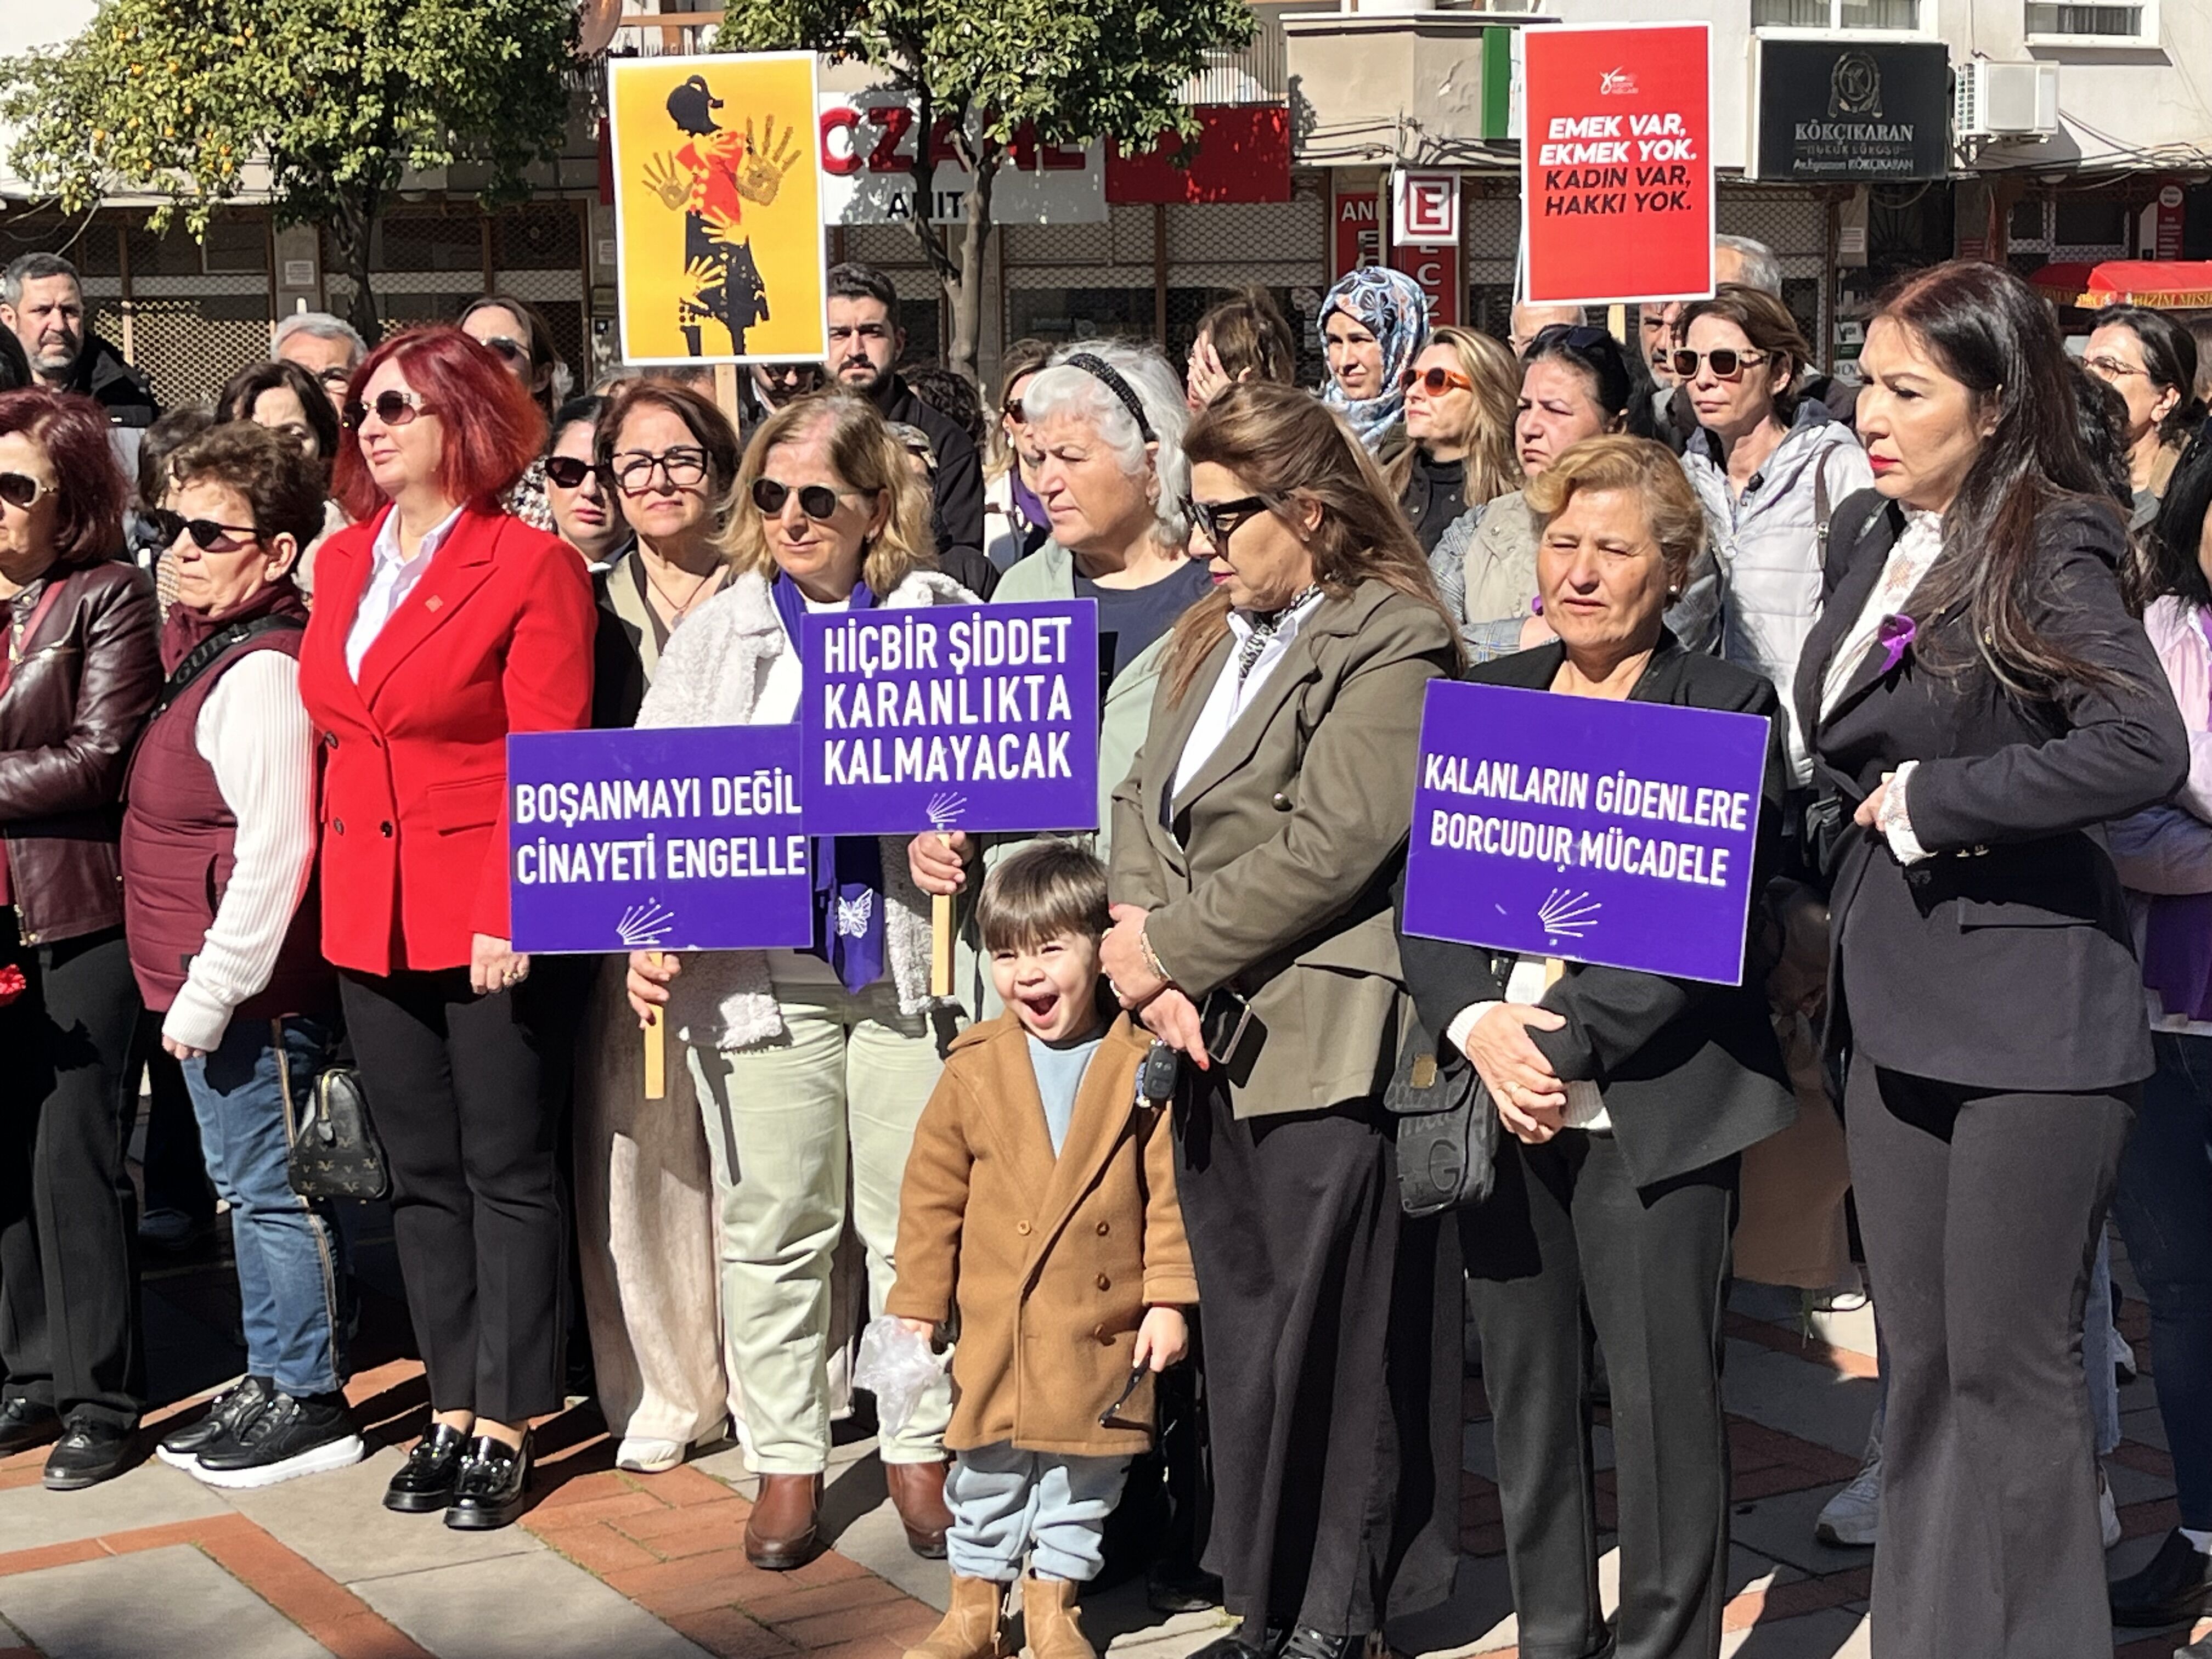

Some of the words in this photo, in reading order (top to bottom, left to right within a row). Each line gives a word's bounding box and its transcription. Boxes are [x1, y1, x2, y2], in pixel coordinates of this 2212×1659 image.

[1539, 140, 1631, 166] EKMEK
[1638, 138, 1697, 162] YOK.
[1549, 115, 1622, 139] EMEK
[1629, 113, 1686, 137] VAR,
[1795, 119, 1914, 145] KÖKÇIKARAN
[1545, 167, 1628, 190] KADIN
[1635, 165, 1691, 188] VAR,
[1545, 193, 1626, 216] HAKKI
[1634, 190, 1691, 212] YOK.
[824, 615, 939, 679] HİÇBİR
[948, 612, 1072, 675] ŞİDDET
[824, 674, 1072, 729] KARANLIKTA
[824, 731, 1072, 786] KALMAYACAK
[516, 777, 701, 827] BOŞANMAYI
[712, 766, 802, 817] DEĞİL
[1425, 753, 1589, 810] KALANLARIN
[1595, 770, 1751, 831] GİDENLERE
[517, 833, 657, 884] CİNAYETİ
[667, 835, 806, 880] ENGELLE
[1430, 809, 1573, 865] BORCUDUR
[1579, 828, 1730, 887] MÜCADELE
